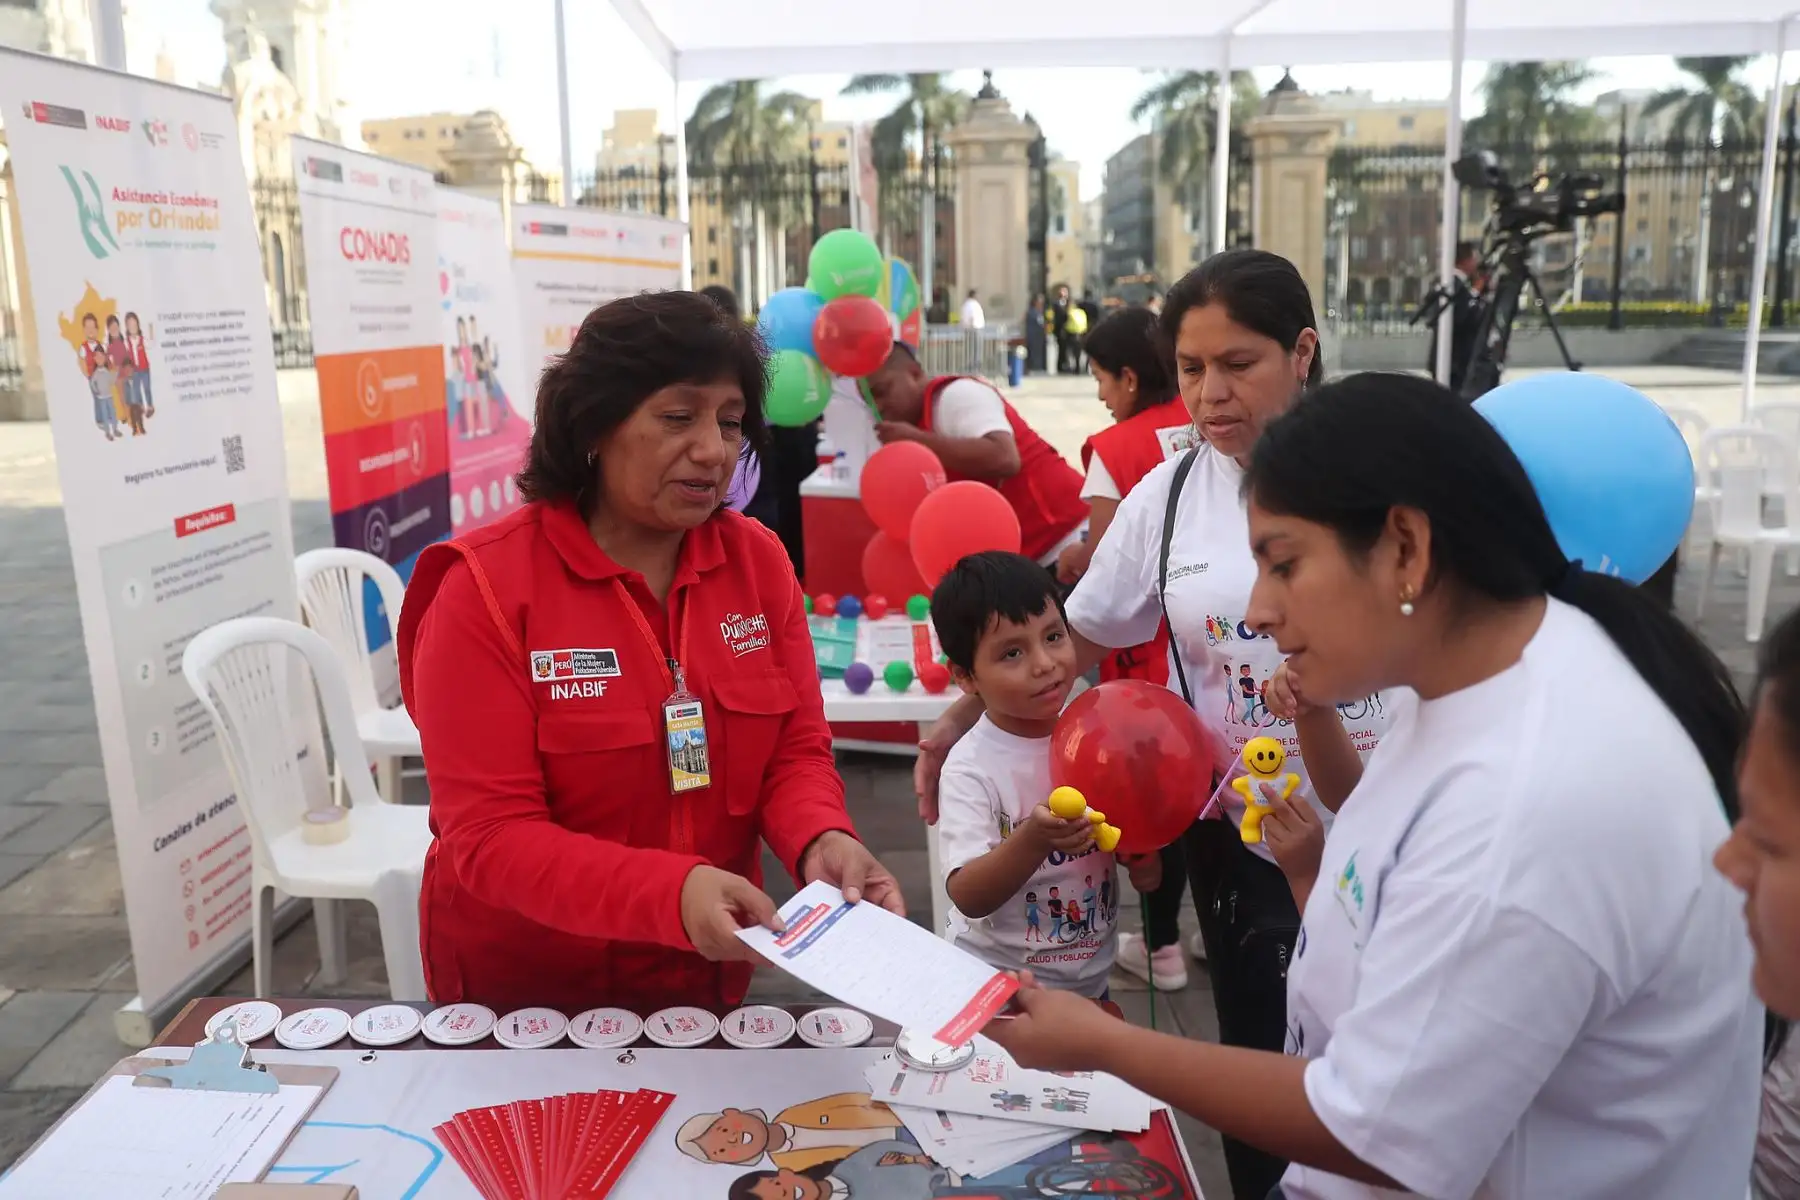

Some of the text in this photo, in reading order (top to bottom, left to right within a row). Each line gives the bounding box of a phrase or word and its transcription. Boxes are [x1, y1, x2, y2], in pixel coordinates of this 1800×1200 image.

[340, 227, 410, 264] CONADIS
[726, 613, 743, 623] Con
[731, 635, 767, 653] Familias
[555, 660, 571, 671] PERÚ
[551, 681, 608, 700] INABIF
[154, 820, 192, 852] Canales
[195, 811, 206, 827] de
[1026, 956, 1050, 964] SALUD
